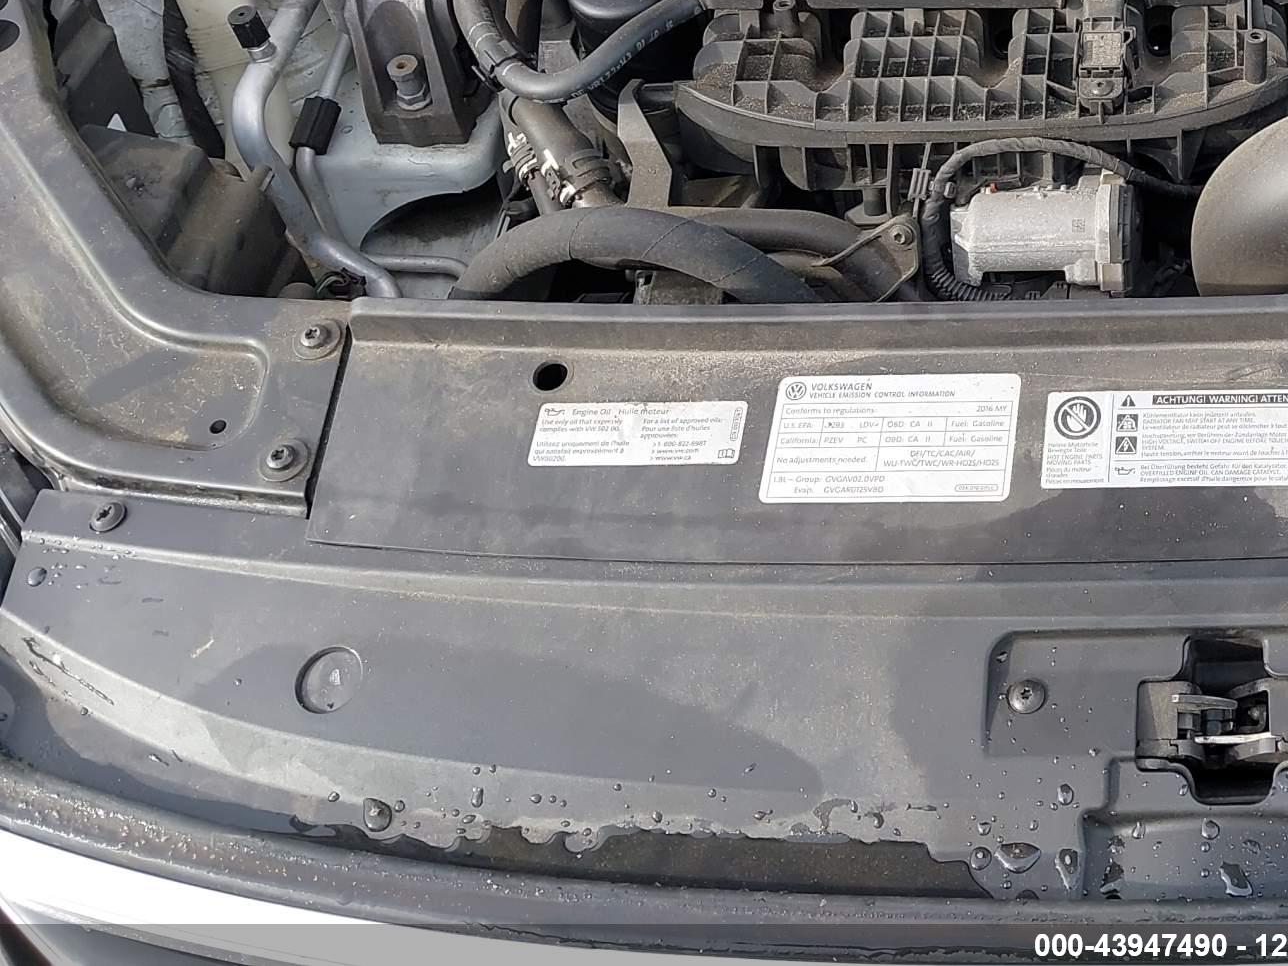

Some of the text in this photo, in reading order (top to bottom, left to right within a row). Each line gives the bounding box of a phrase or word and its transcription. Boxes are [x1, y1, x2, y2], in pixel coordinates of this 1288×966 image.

[811, 383, 873, 391] VOLKSWAGEN
[1156, 395, 1206, 404] ACHTUNG!
[1208, 395, 1258, 403] WARNING!
[572, 409, 598, 417] Engine
